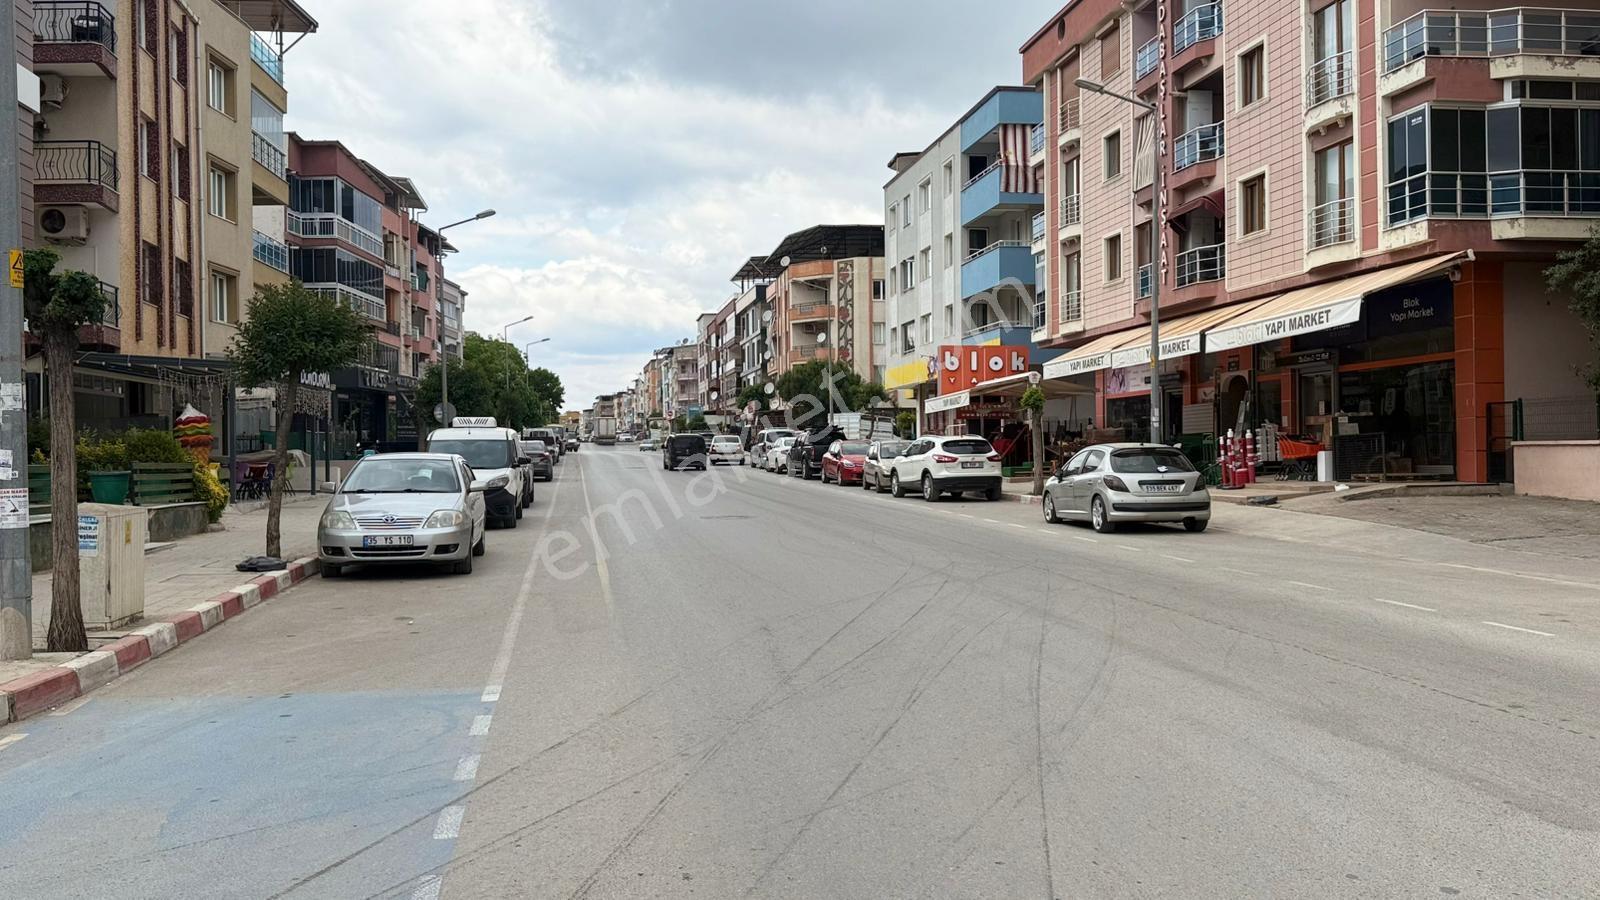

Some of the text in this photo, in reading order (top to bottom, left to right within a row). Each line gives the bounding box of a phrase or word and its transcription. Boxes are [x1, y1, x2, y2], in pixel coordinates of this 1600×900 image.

[1157, 0, 1169, 157] DABAŞLAR
[1407, 306, 1434, 320] Market
[1265, 322, 1286, 336] YAPI
[1288, 309, 1332, 332] MARKET
[1161, 339, 1191, 355] MARKET
[944, 351, 1026, 372] blok
[1069, 361, 1081, 372] YAPI
[1082, 355, 1105, 369] MARKET
[368, 536, 378, 545] 35
[398, 536, 412, 545] 110
